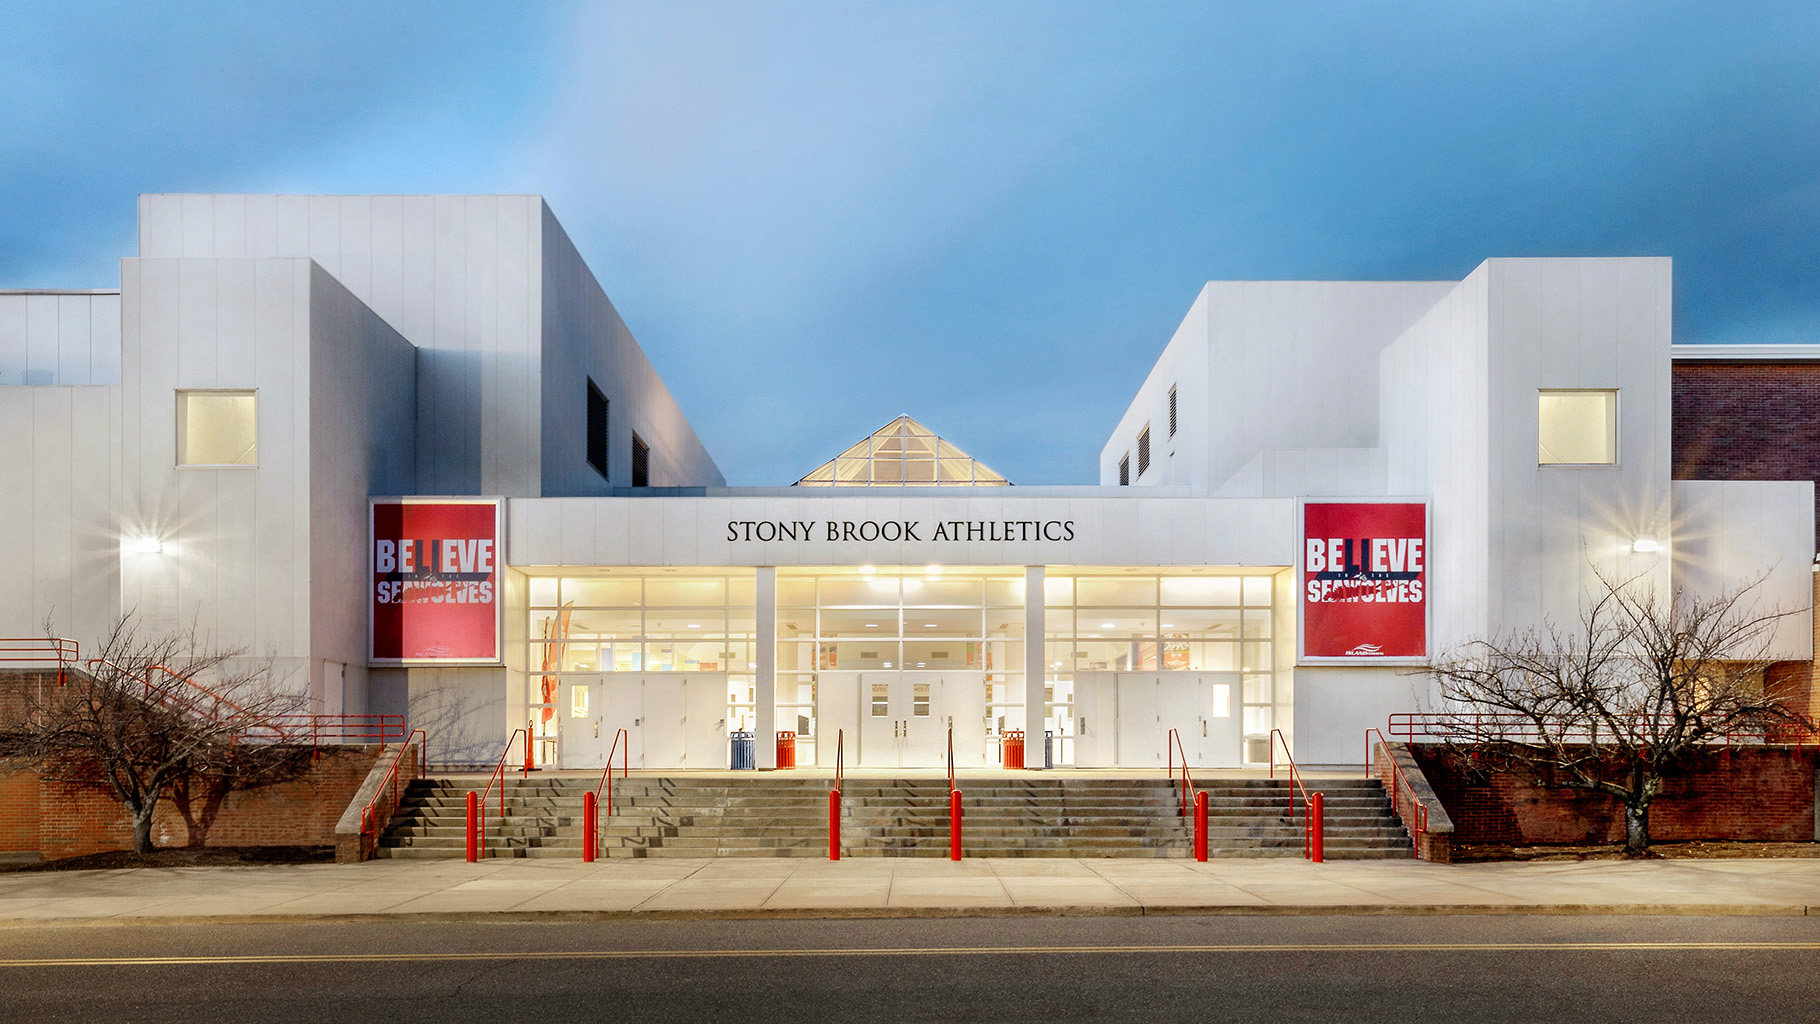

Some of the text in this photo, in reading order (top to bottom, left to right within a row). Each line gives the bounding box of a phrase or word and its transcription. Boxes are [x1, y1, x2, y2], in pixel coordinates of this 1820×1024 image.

[727, 521, 1075, 542] STONY BROOK ATHLETICS
[376, 539, 493, 573] BELIEVE
[1306, 538, 1423, 572] BELIEVE
